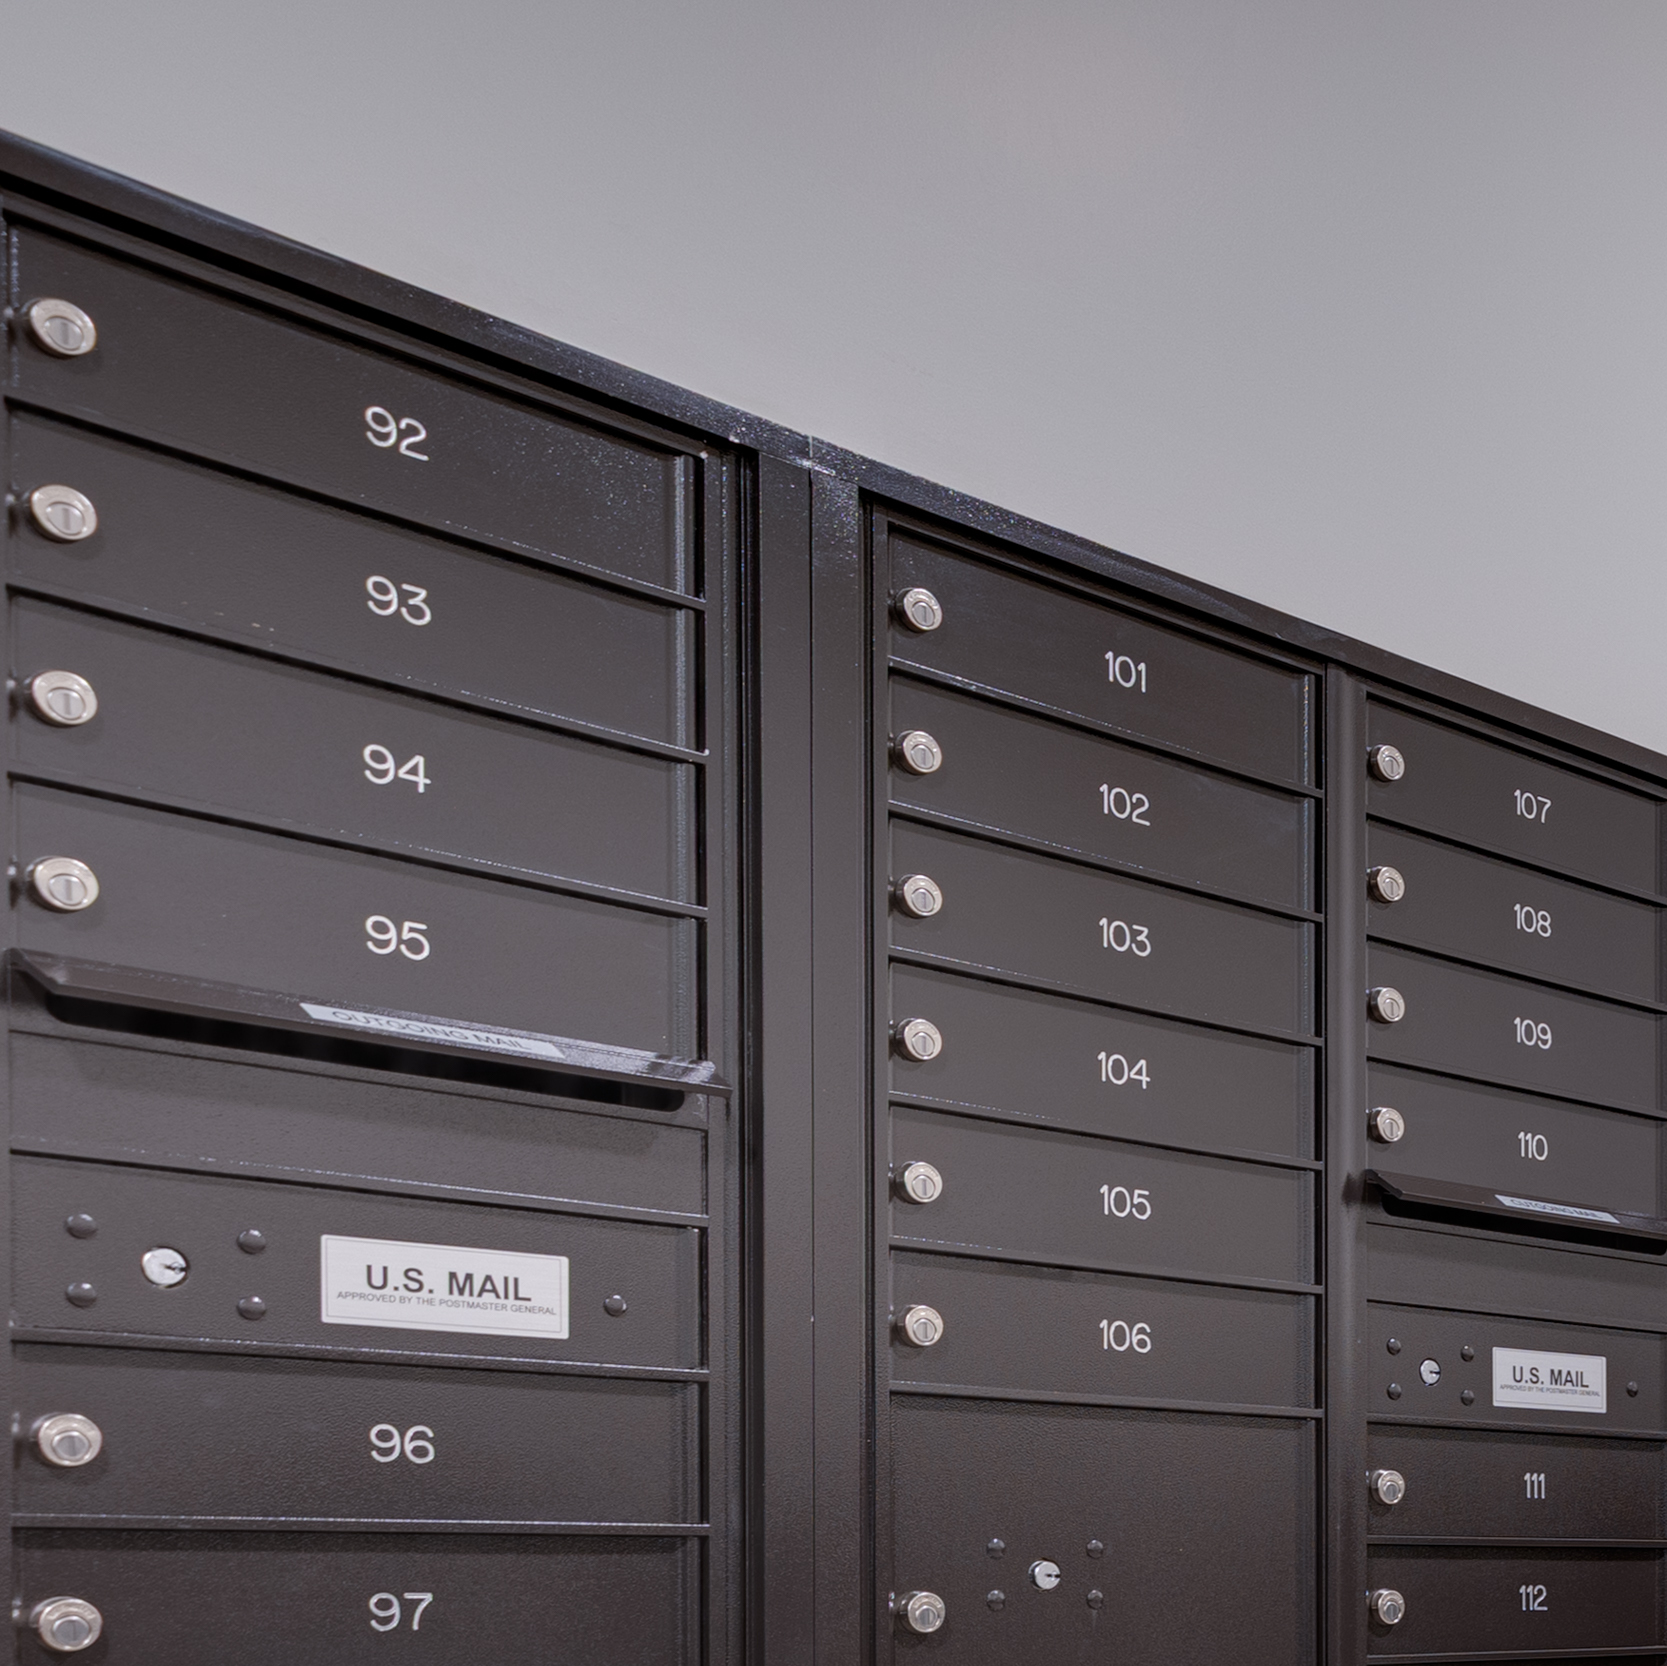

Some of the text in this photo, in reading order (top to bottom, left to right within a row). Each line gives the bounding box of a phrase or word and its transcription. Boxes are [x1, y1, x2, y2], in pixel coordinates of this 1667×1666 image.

[365, 406, 429, 461] 92
[366, 575, 432, 626] 93
[1104, 650, 1146, 693] 101
[363, 744, 432, 794] 94
[1099, 783, 1151, 827] 102
[1513, 789, 1552, 824] 107
[365, 915, 430, 961] 95
[1098, 917, 1152, 957] 103
[1513, 903, 1552, 938] 108
[331, 1009, 532, 1050] OUTGOING MAIL
[1513, 1016, 1552, 1050] 109
[1097, 1051, 1151, 1090] 104
[1517, 1131, 1548, 1161] 110
[1099, 1184, 1152, 1220] 105
[366, 1263, 533, 1303] U.S. MAIL
[336, 1291, 558, 1317] APPROVED BY THE POSTMASTER GENERAL
[1099, 1319, 1152, 1354] 106
[1499, 1383, 1527, 1392] APPROVED
[1545, 1387, 1578, 1395] POSTMASTER
[1578, 1389, 1601, 1397] GENERAL
[1512, 1365, 1590, 1388] U.S. MAIL
[369, 1423, 435, 1464] 96
[1523, 1472, 1546, 1500] 111
[368, 1592, 434, 1632] 97
[1519, 1584, 1548, 1611] 112
